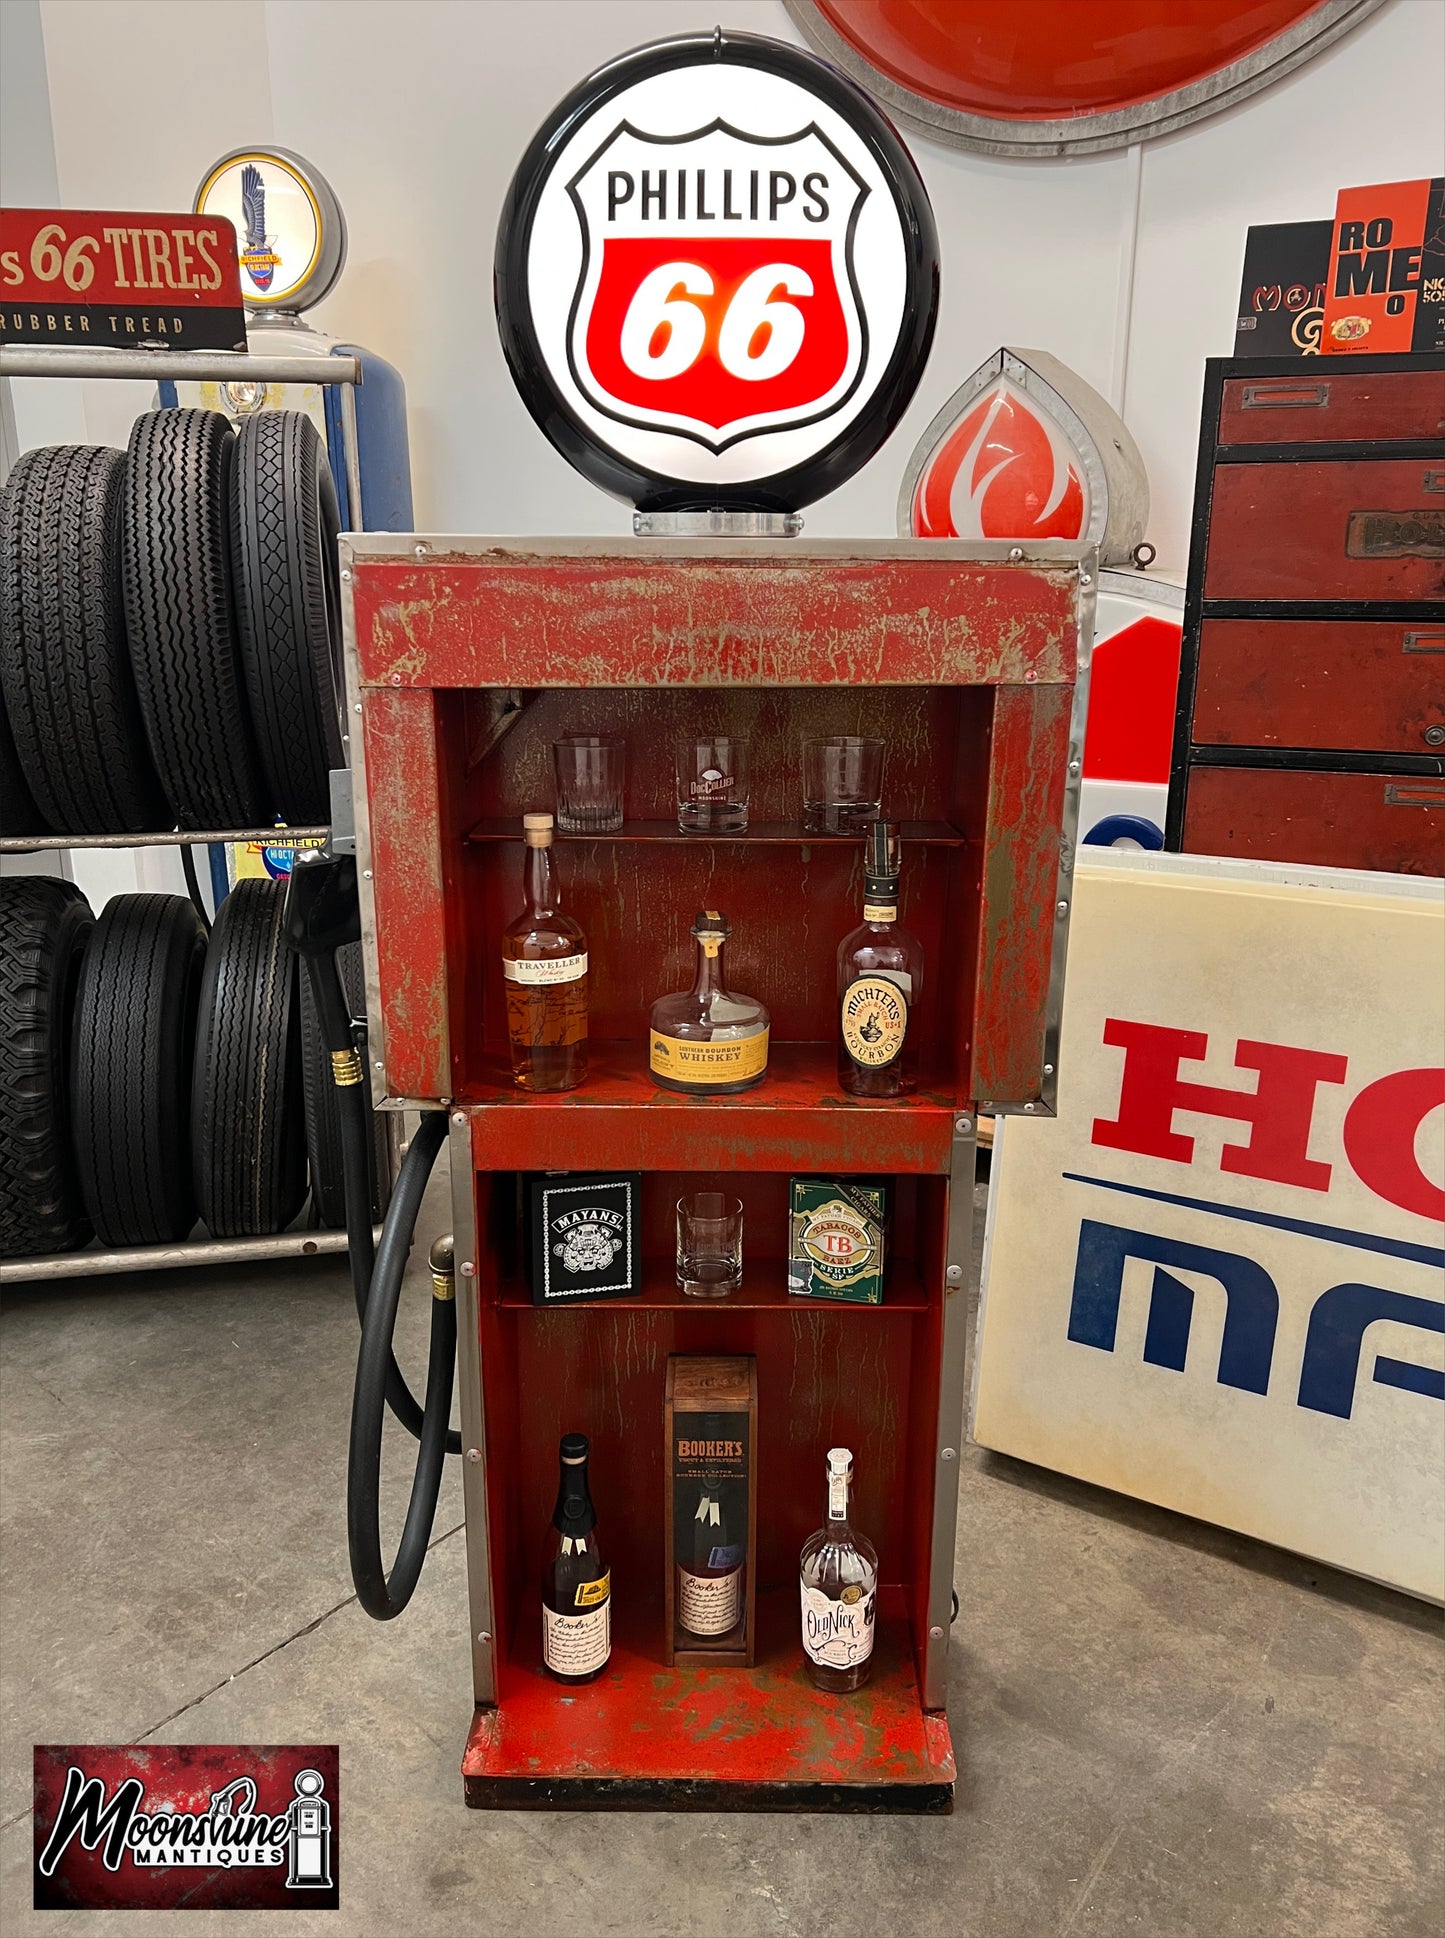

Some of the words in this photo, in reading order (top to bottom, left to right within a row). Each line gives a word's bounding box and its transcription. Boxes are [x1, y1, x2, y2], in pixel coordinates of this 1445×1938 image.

[607, 169, 830, 223] PHILLIPS
[1339, 217, 1394, 252] RO
[30, 224, 99, 292] 66
[103, 227, 222, 290] TIRES
[1335, 246, 1422, 298] ME
[0, 313, 90, 331] RUBBER
[108, 316, 183, 333] TREAD
[620, 261, 815, 382] 66
[256, 838, 320, 848] RICHFIELD
[517, 957, 581, 970] TRAVELLER
[848, 988, 900, 1020] MICHTER'S
[847, 1031, 900, 1059] BOURBON
[680, 1052, 742, 1062] WHISKEY
[557, 1210, 619, 1229] MAYANS
[812, 1222, 862, 1240] TABACOS
[823, 1234, 853, 1255] TB
[822, 1254, 852, 1266] BAEZ
[820, 1265, 854, 1275] SERIE
[678, 1440, 743, 1457] BOOKER'S
[685, 1577, 733, 1592] Booker's
[554, 1614, 602, 1630] Booker's
